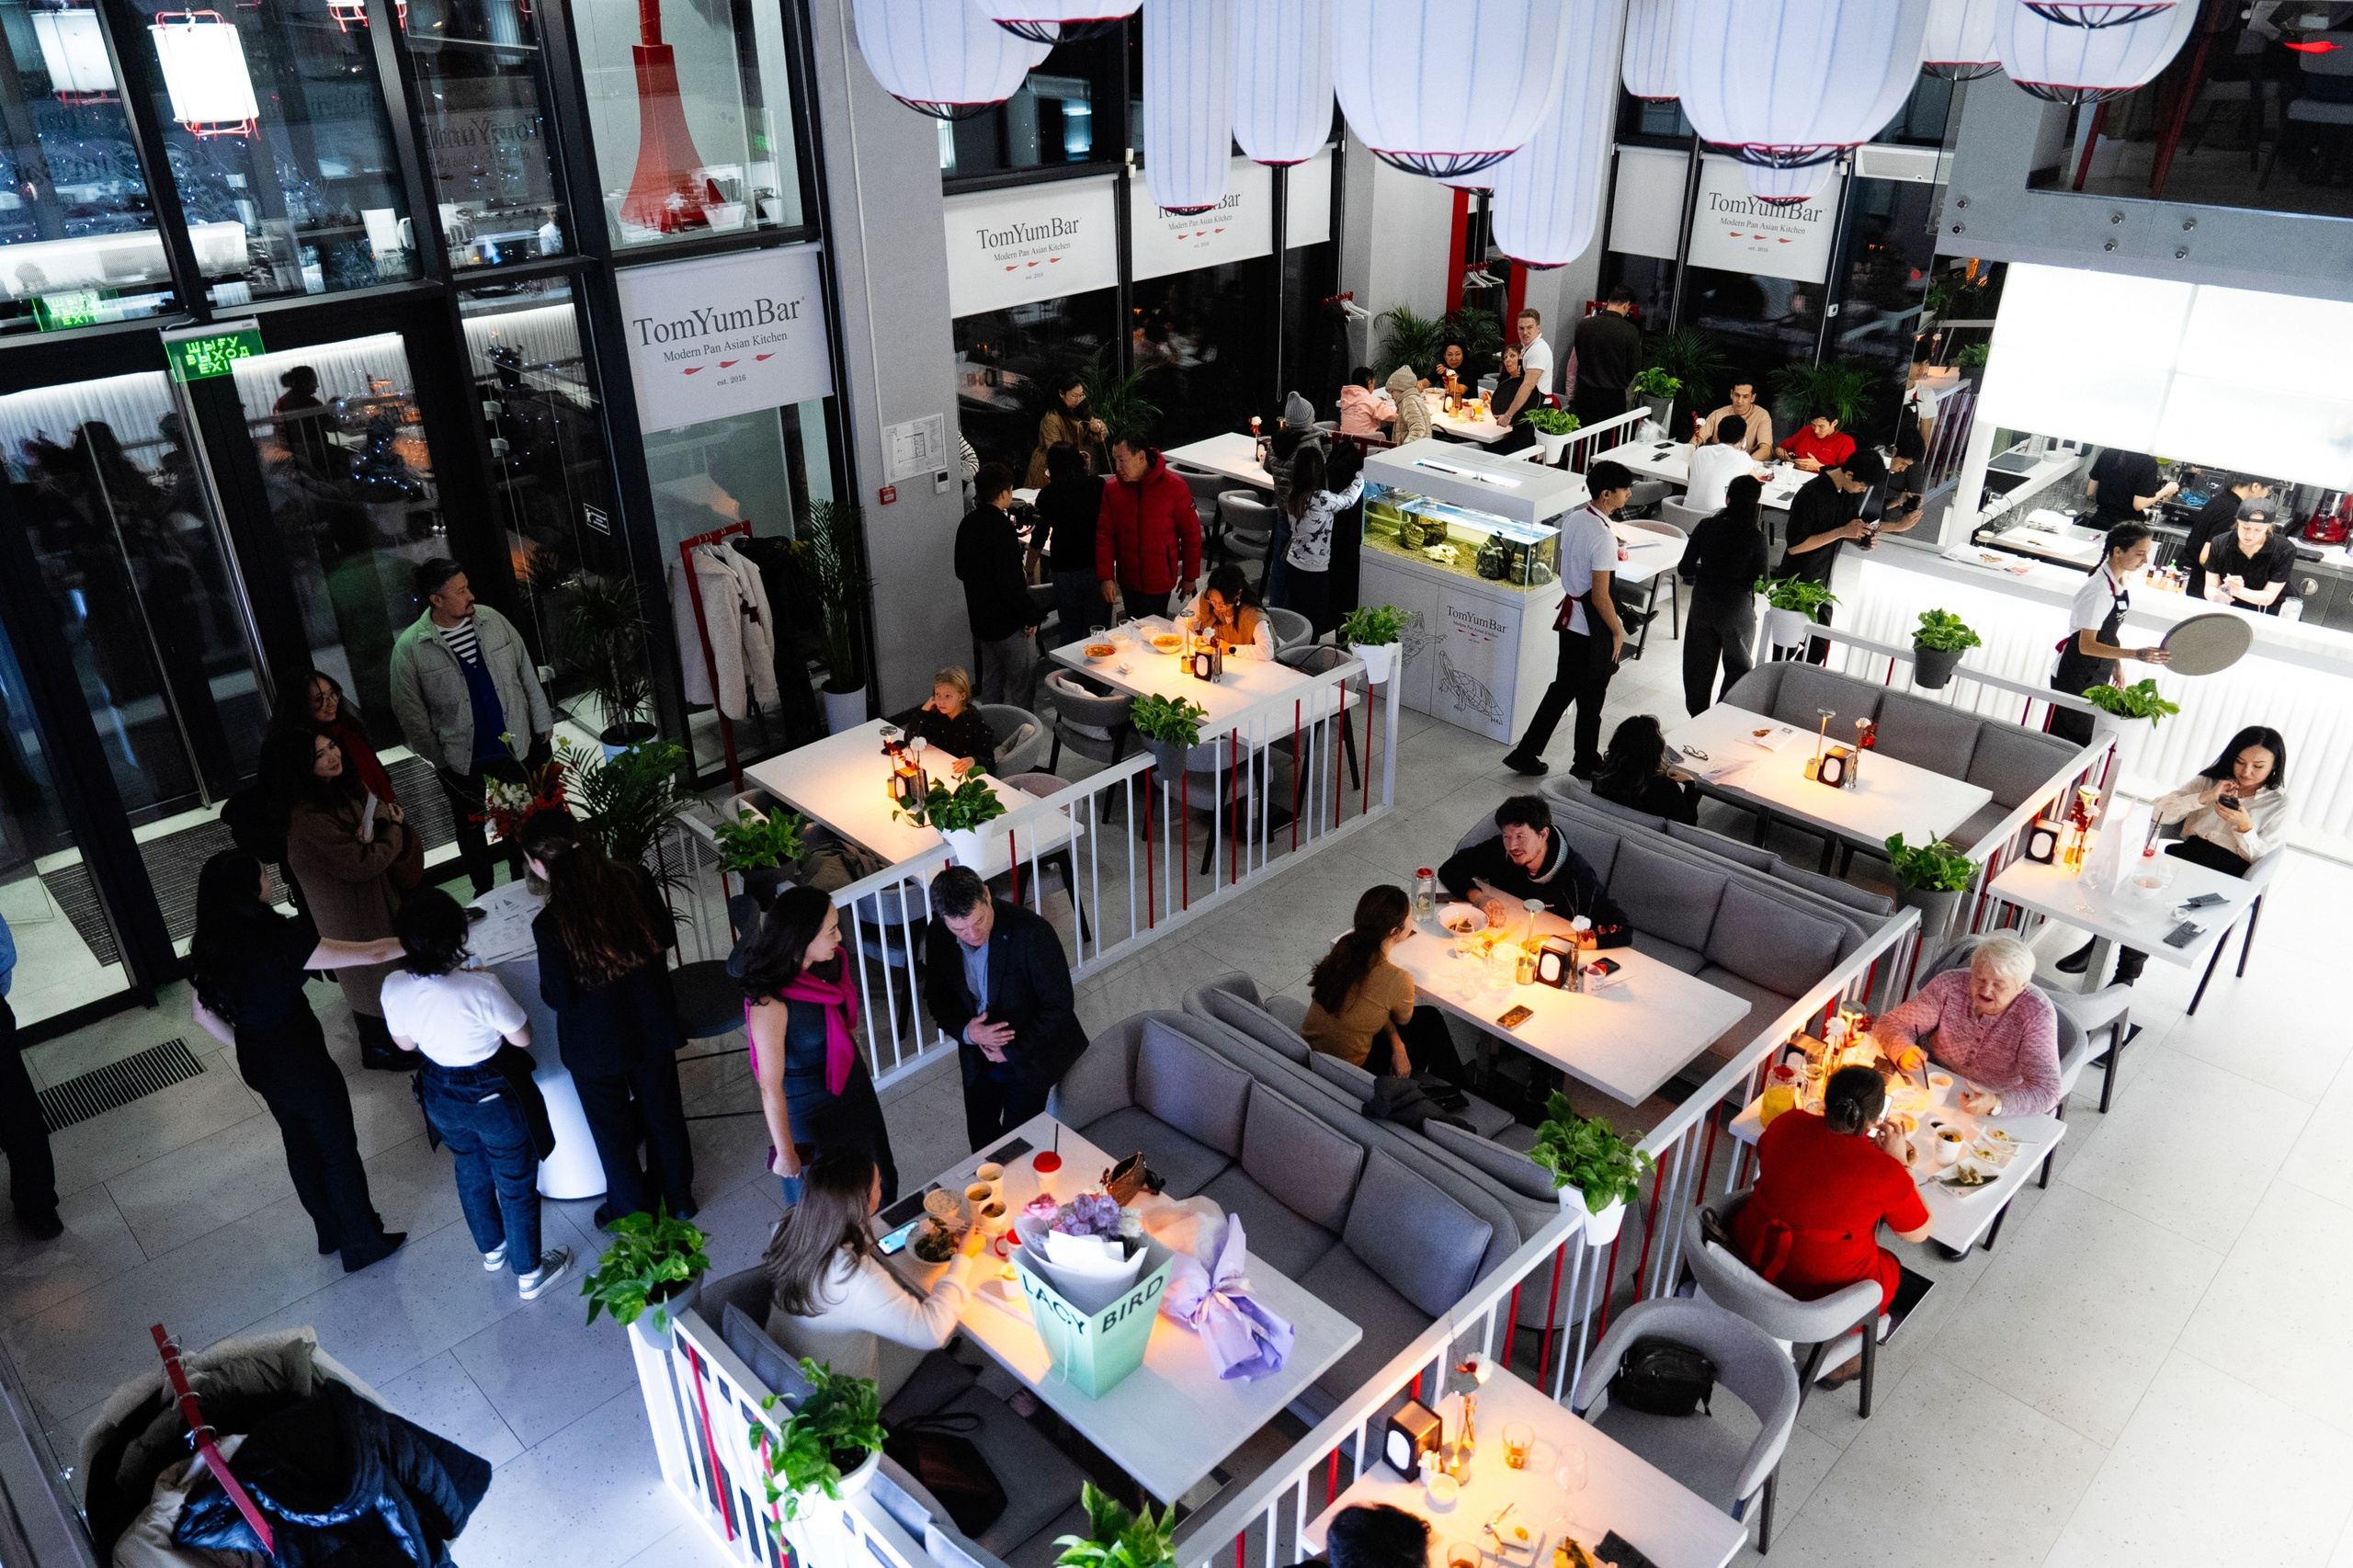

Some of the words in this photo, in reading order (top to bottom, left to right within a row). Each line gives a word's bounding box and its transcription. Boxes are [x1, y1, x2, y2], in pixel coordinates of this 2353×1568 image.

[1168, 222, 1188, 231] Modern
[1213, 214, 1233, 222] Kitchen
[1720, 217, 1745, 227] Modern
[1746, 221, 1758, 229] Pan
[1760, 222, 1779, 231] Asian
[1779, 224, 1806, 234] Kitchen
[976, 217, 1079, 249] TomYumBar
[994, 252, 1017, 262] Modern
[1018, 249, 1029, 257] Pan
[1030, 246, 1048, 256] Asian
[1048, 242, 1071, 252] Kitchen
[62, 312, 98, 325] EXIT
[632, 297, 801, 347] TomYumBar
[186, 346, 250, 366] ВЫХОД
[663, 348, 701, 362] Modern
[703, 343, 722, 355] Pan
[723, 337, 750, 350] Asian
[752, 330, 788, 346] Kitchen
[199, 360, 228, 374] EXI
[717, 378, 729, 386] est.
[730, 374, 746, 384] 2016
[1447, 605, 1507, 633] TomYumBar
[1022, 1273, 1085, 1335] LACY
[1101, 1275, 1164, 1334] BIRD
